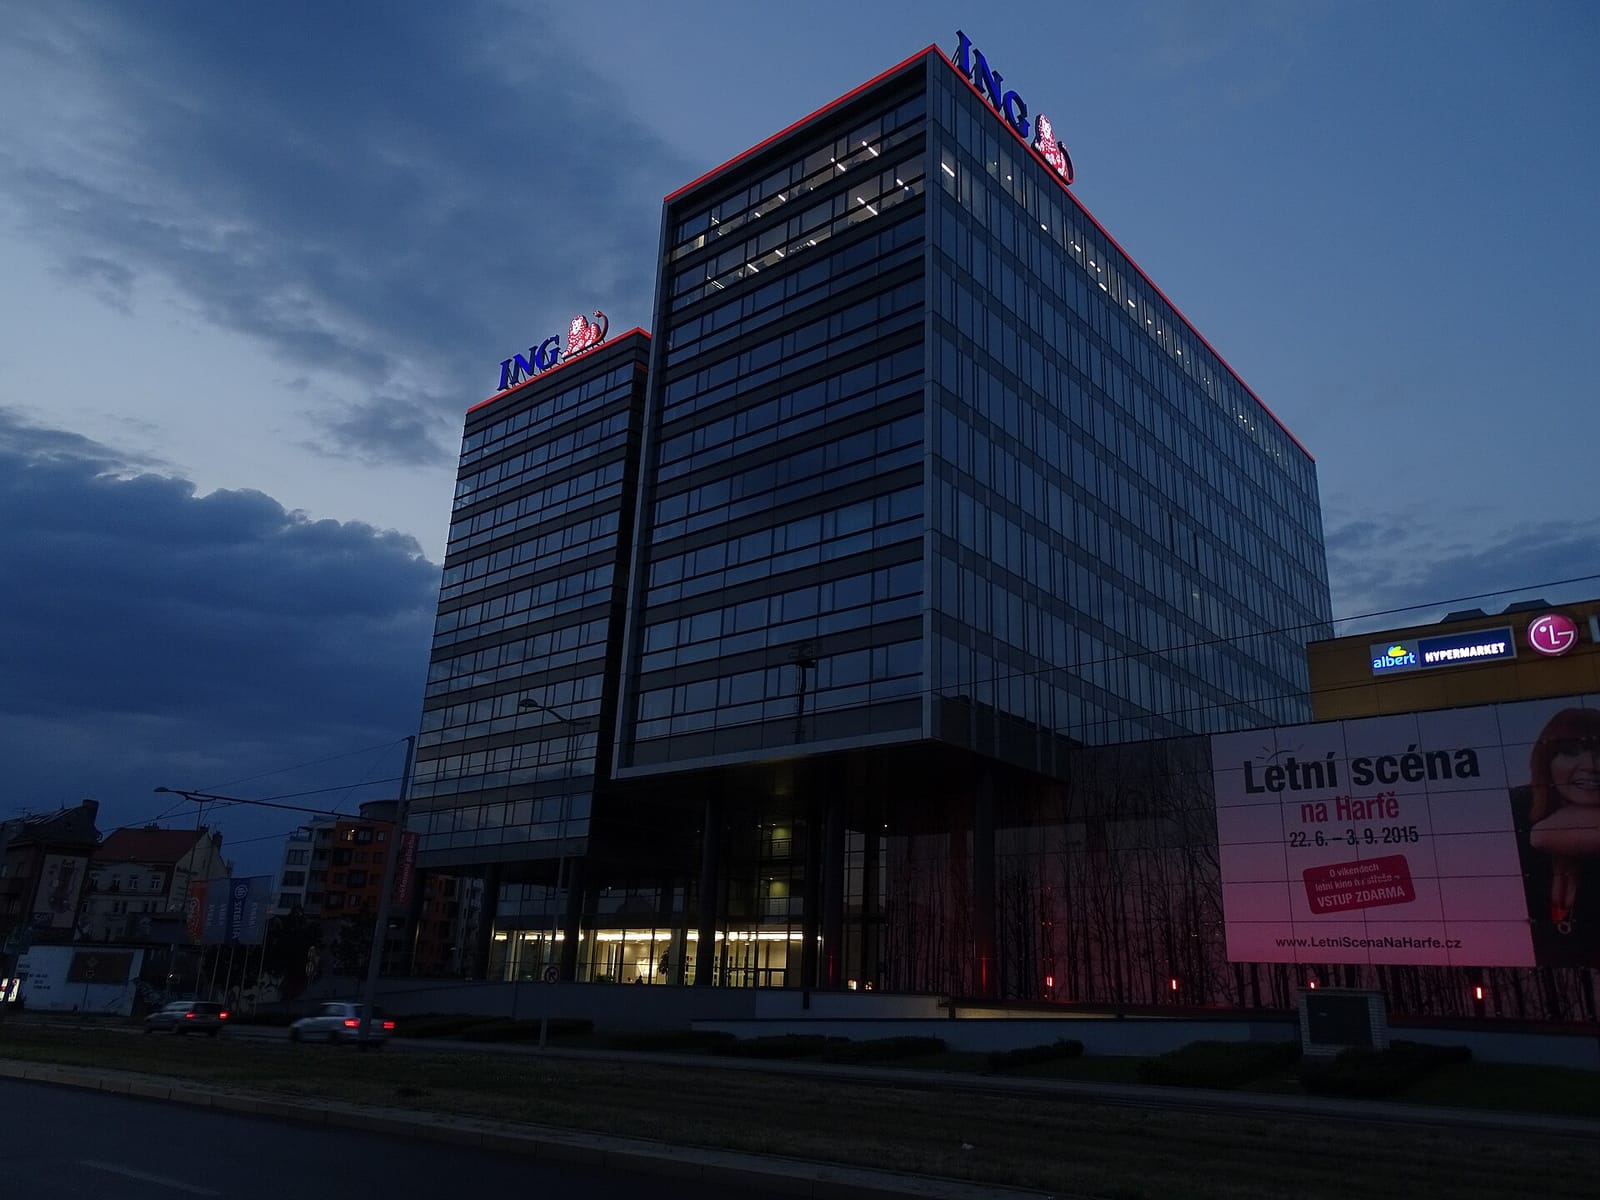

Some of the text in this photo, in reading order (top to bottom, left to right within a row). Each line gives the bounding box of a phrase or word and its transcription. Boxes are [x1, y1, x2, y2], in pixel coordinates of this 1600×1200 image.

[956, 30, 1030, 138] ING
[497, 334, 561, 391] ING
[1530, 616, 1575, 653] LG
[1373, 642, 1505, 669] albert HYPERMARKET
[1244, 744, 1480, 793] Letní scéna
[1301, 792, 1399, 823] na Harfě
[1290, 832, 1311, 847] 22.
[1315, 831, 1328, 846] 6.
[1364, 828, 1378, 844] 9.
[1382, 826, 1419, 843] 2015
[1317, 885, 1406, 907] VSTUP ZDARMA
[1276, 937, 1463, 949] www.LetniScenaNaHarfe.cz
